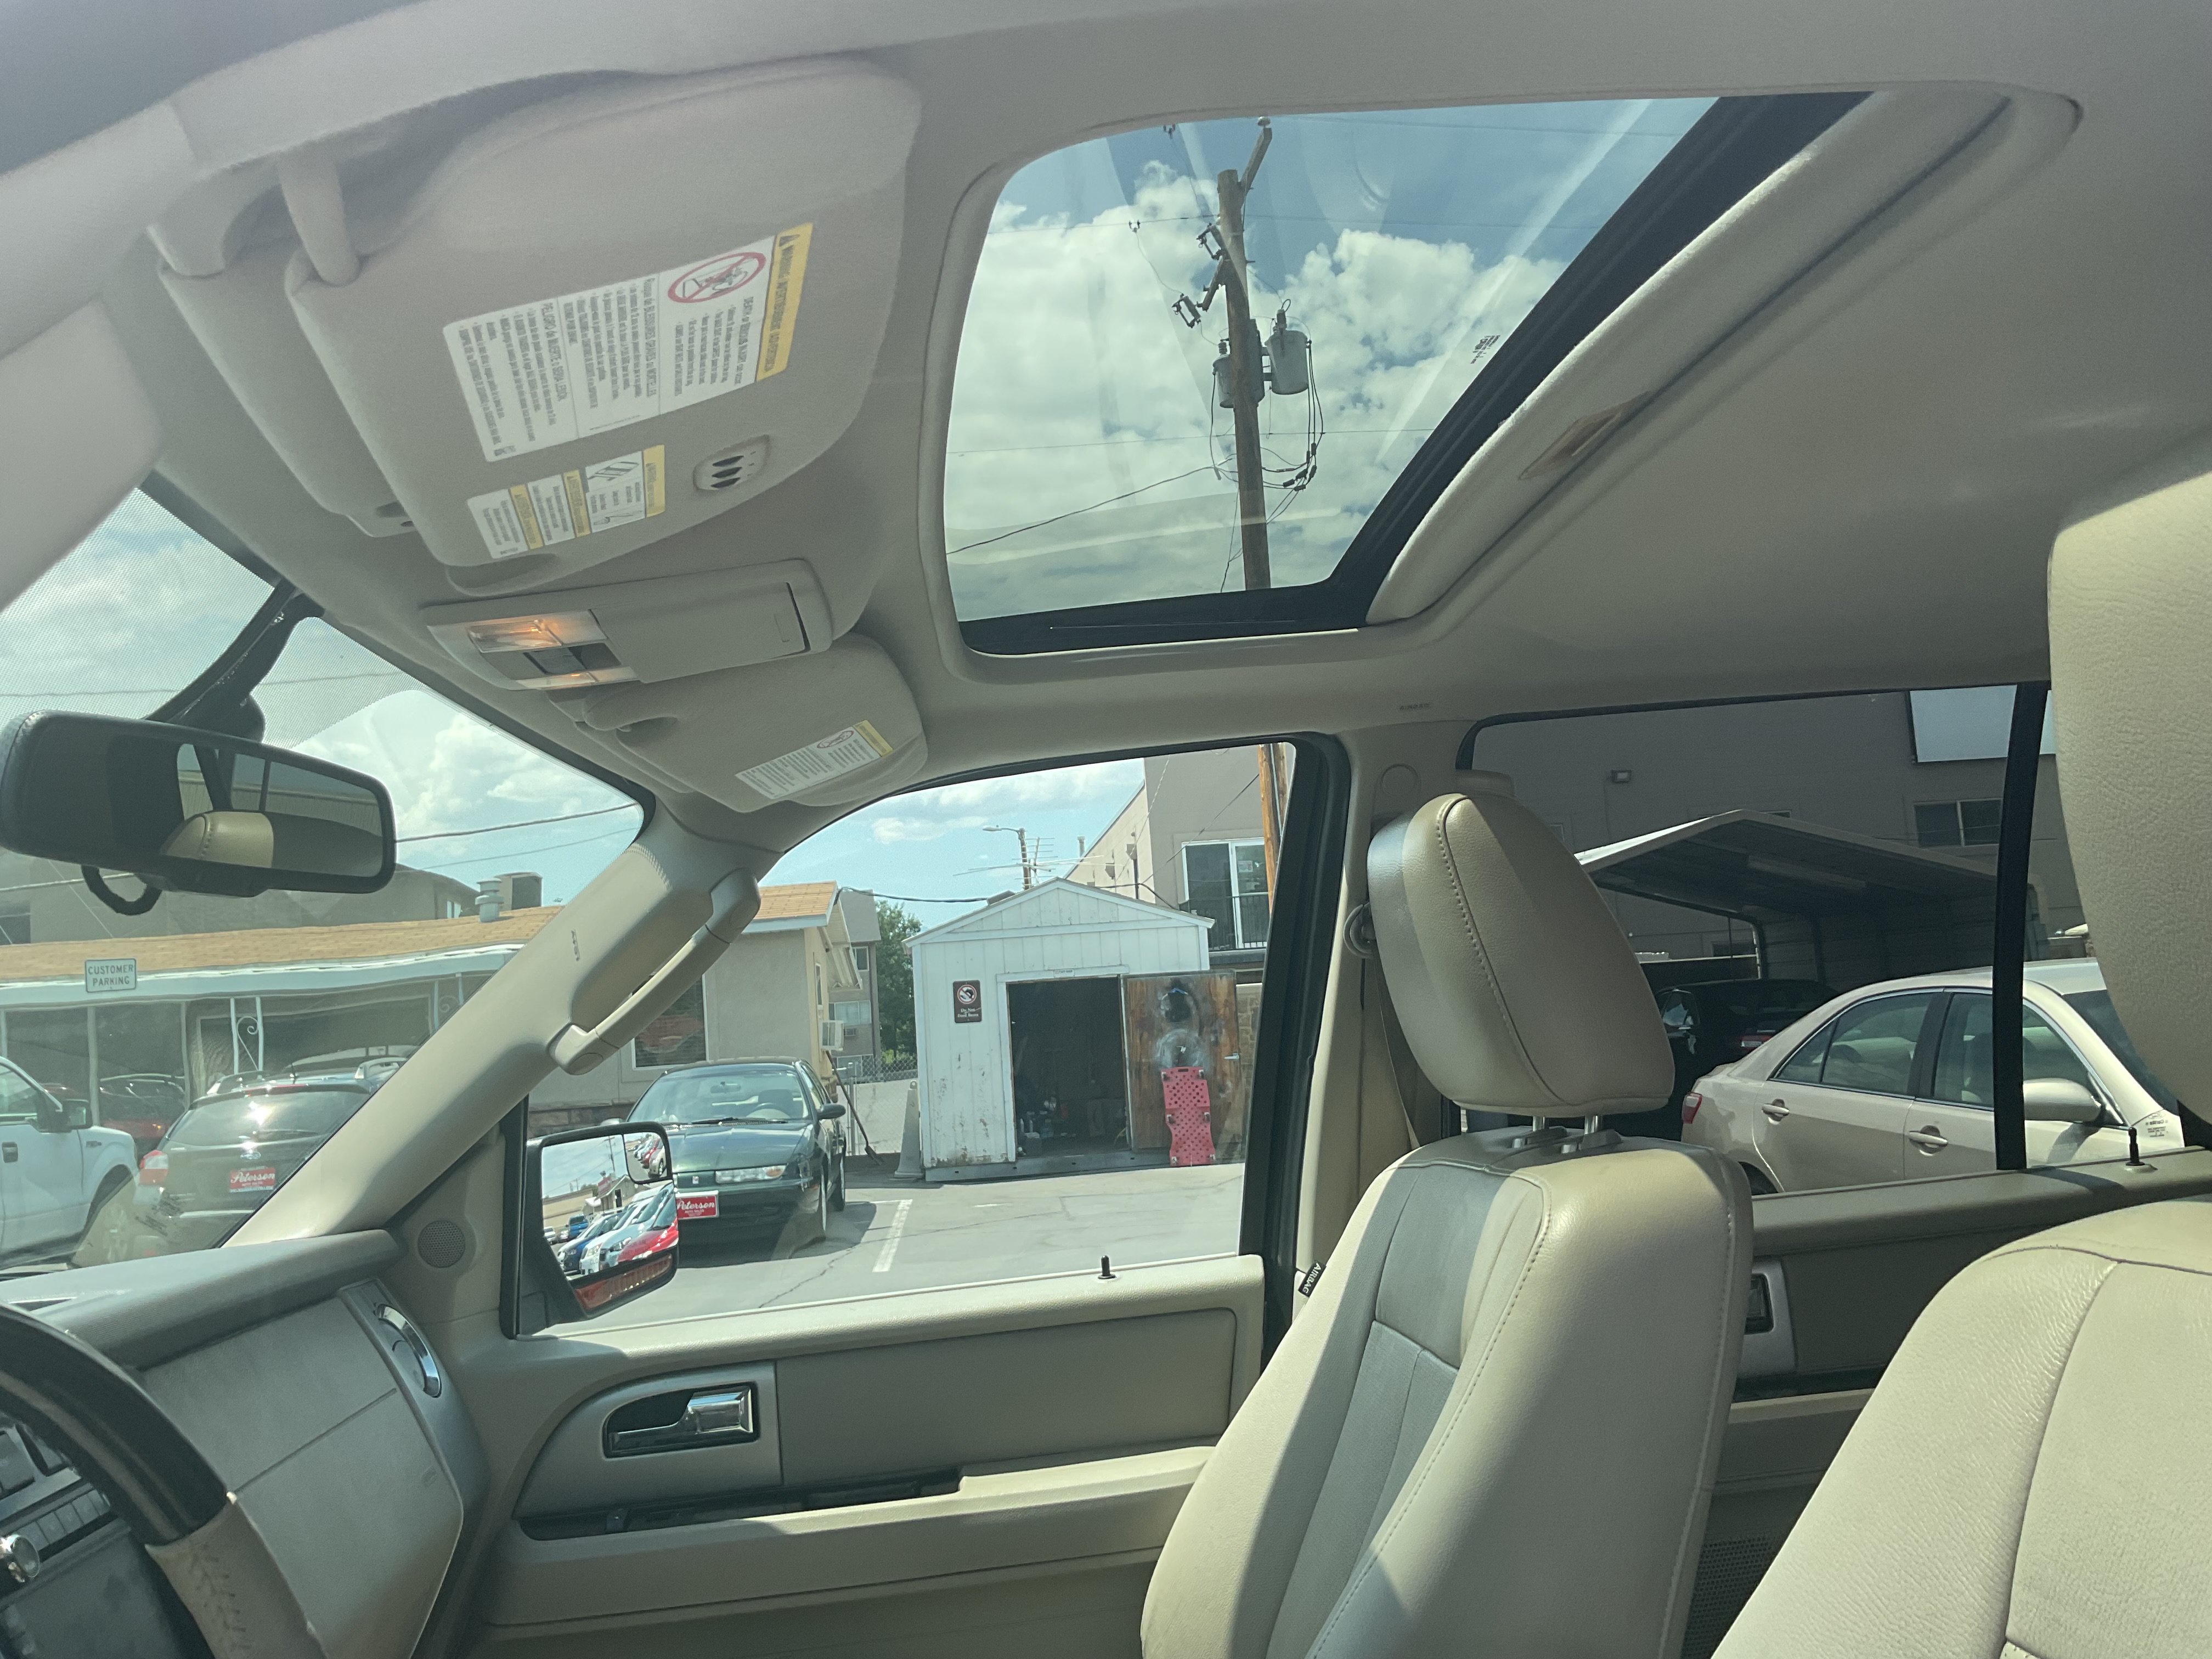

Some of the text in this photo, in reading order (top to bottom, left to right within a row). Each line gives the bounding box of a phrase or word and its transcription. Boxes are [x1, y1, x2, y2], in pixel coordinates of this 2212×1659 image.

[88, 964, 133, 975] CUSTOMER
[93, 976, 130, 986] PARKING
[230, 1172, 275, 1183] Peterson
[676, 1200, 715, 1210] Peterson
[1302, 1262, 1322, 1294] AIRBAG
